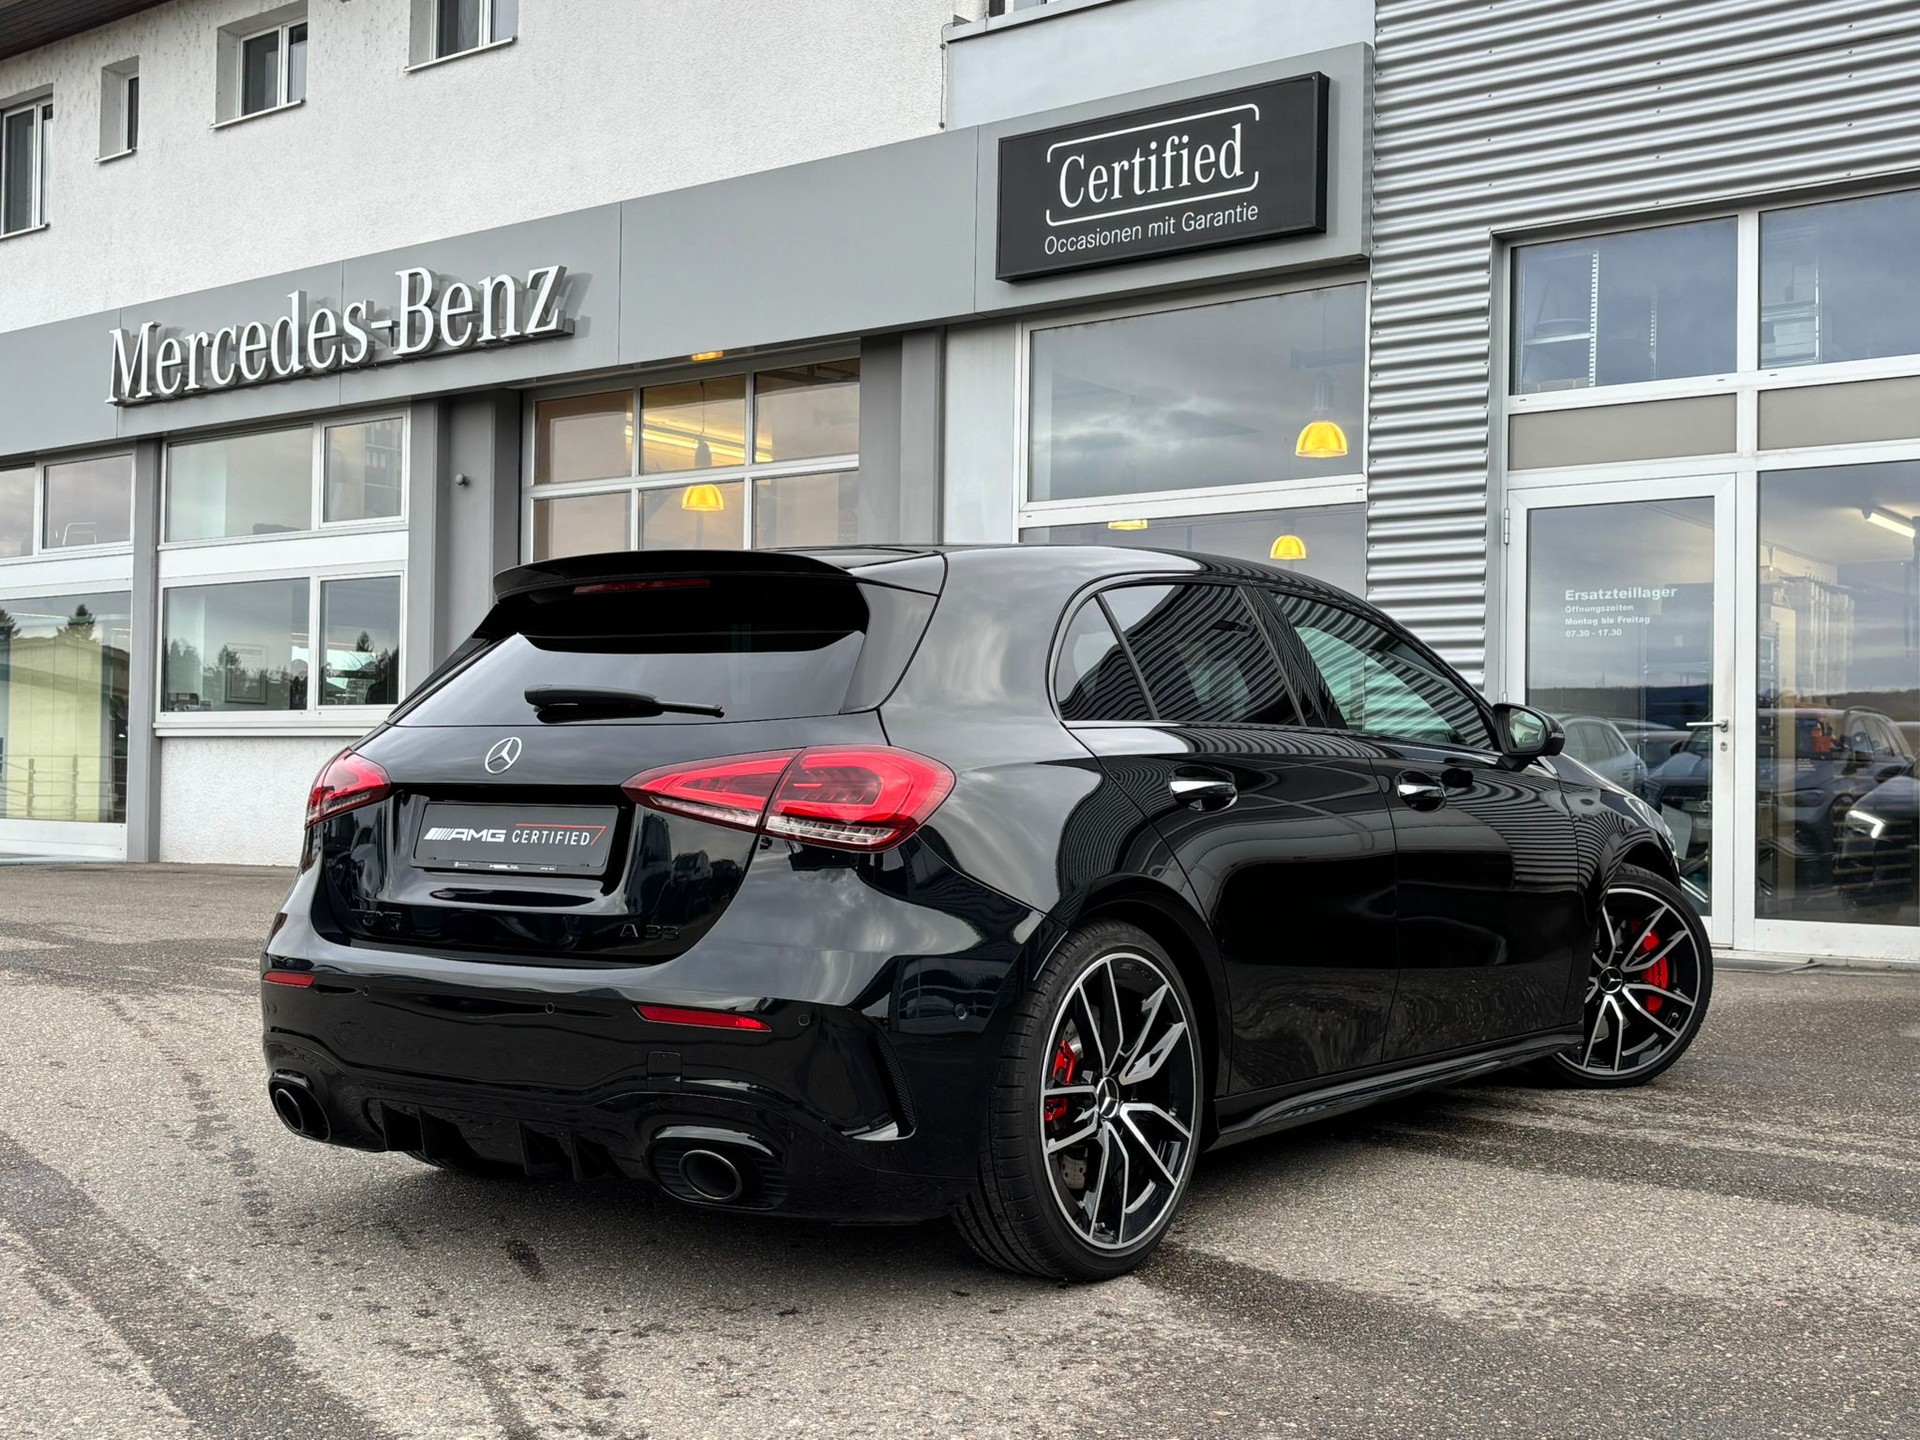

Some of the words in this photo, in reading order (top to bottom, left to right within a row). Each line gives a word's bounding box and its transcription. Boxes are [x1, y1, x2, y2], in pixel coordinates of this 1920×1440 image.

[1058, 122, 1245, 209] Certified
[1044, 223, 1142, 256] Occasionen
[1147, 215, 1176, 238] mit
[1181, 202, 1259, 233] Garantie
[105, 265, 567, 405] Mercedes-Benz
[1565, 587, 1678, 601] Ersatzteillager
[1565, 616, 1598, 626] Montag
[1601, 616, 1615, 625] bis
[1617, 615, 1651, 625] Freitag
[1565, 629, 1590, 638] 07.30
[1598, 629, 1623, 637] 17.30
[449, 828, 507, 843] AMG
[512, 830, 590, 846] CERTIFIED
